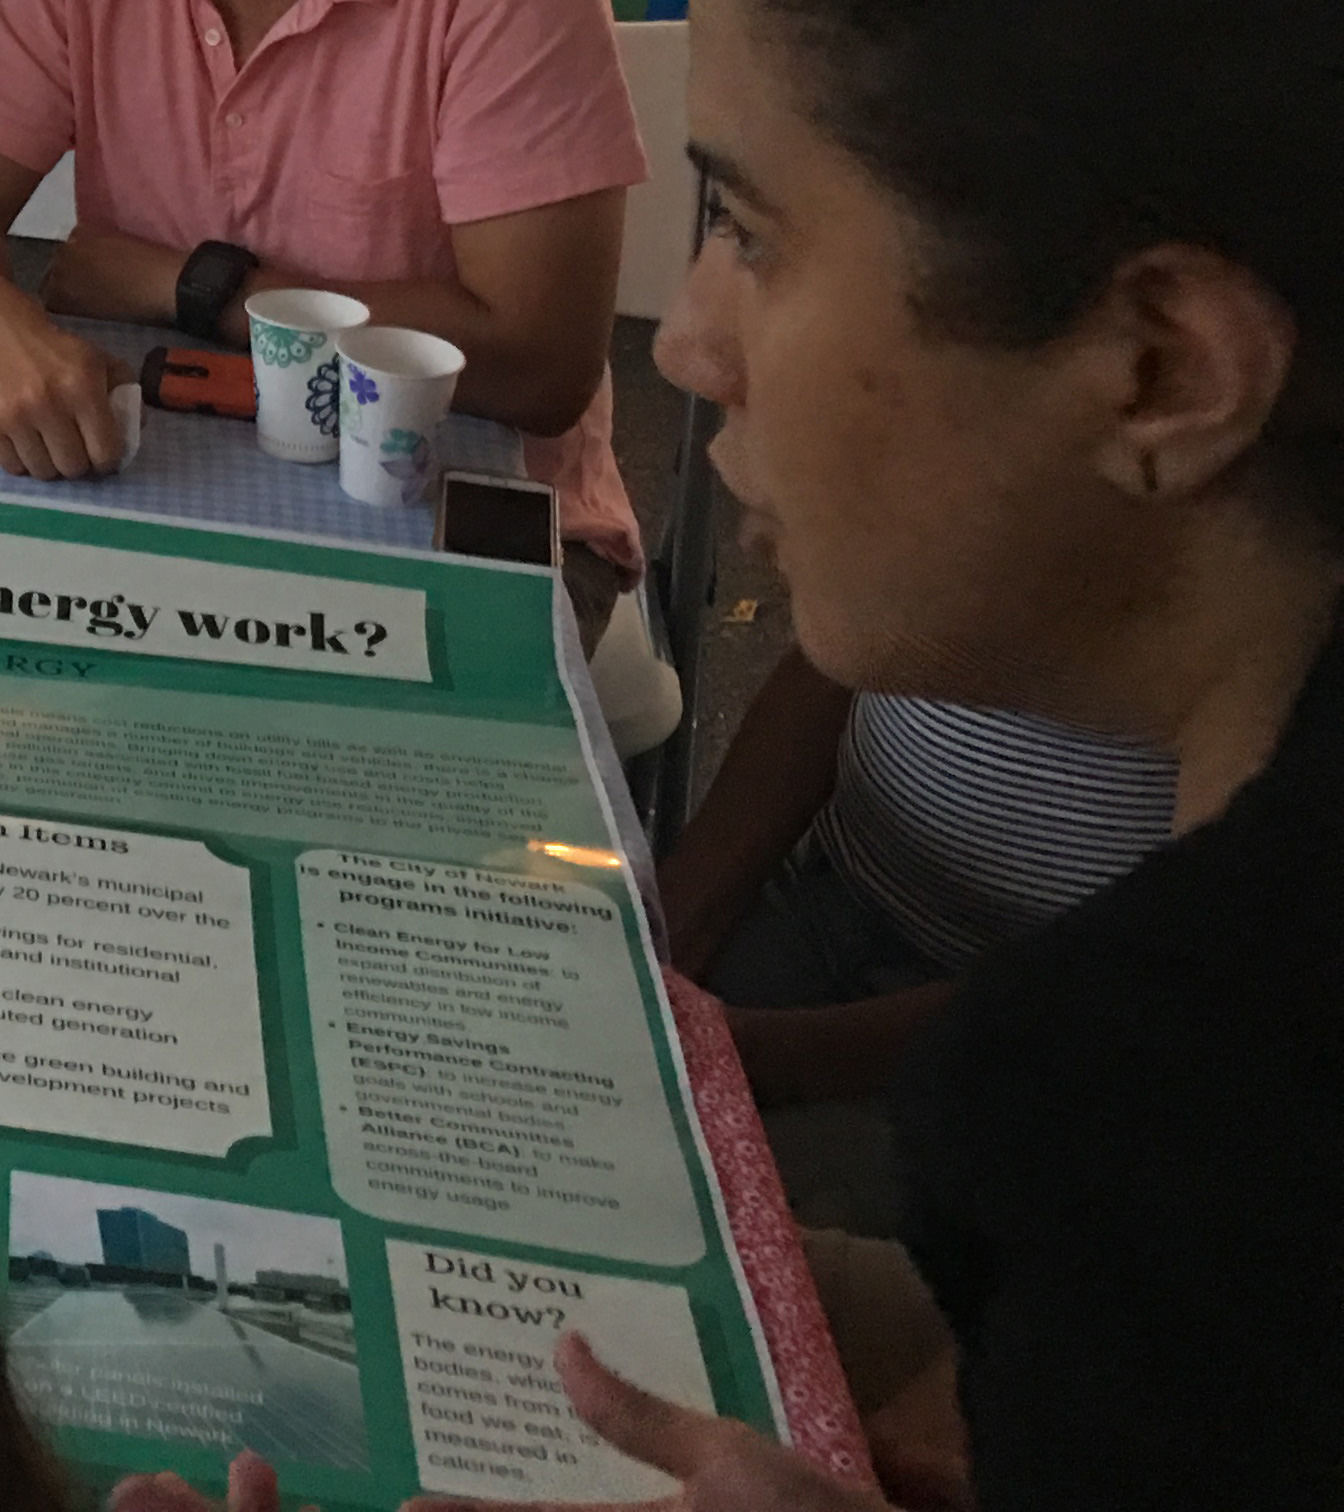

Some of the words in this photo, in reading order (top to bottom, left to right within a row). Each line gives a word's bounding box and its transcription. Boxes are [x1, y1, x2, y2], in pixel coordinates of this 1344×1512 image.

[177, 603, 387, 657] work?
[20, 824, 128, 853] Items
[98, 877, 202, 904] municipal
[337, 853, 381, 867] The
[389, 860, 435, 876] City
[444, 868, 467, 879] of
[475, 872, 565, 894] Newark
[13, 886, 39, 901] 20
[47, 892, 129, 915] percent
[138, 907, 185, 922] over
[195, 912, 229, 929] the
[327, 869, 415, 891] engage
[423, 881, 445, 894] in
[453, 885, 490, 900] the
[499, 892, 612, 921] following
[339, 890, 456, 917] programs
[57, 933, 82, 948] for
[333, 922, 389, 939] Clean
[396, 930, 467, 951] Energy
[473, 941, 499, 954] for
[507, 946, 549, 960] Low
[0, 947, 41, 963] and
[50, 954, 179, 982] institutional
[1, 988, 63, 1007] clean
[72, 1000, 152, 1022] energy
[424, 1251, 494, 1283] Did
[506, 1270, 582, 1301] you
[428, 1286, 566, 1329] know?
[410, 1331, 455, 1352] The
[463, 1343, 544, 1370] energy
